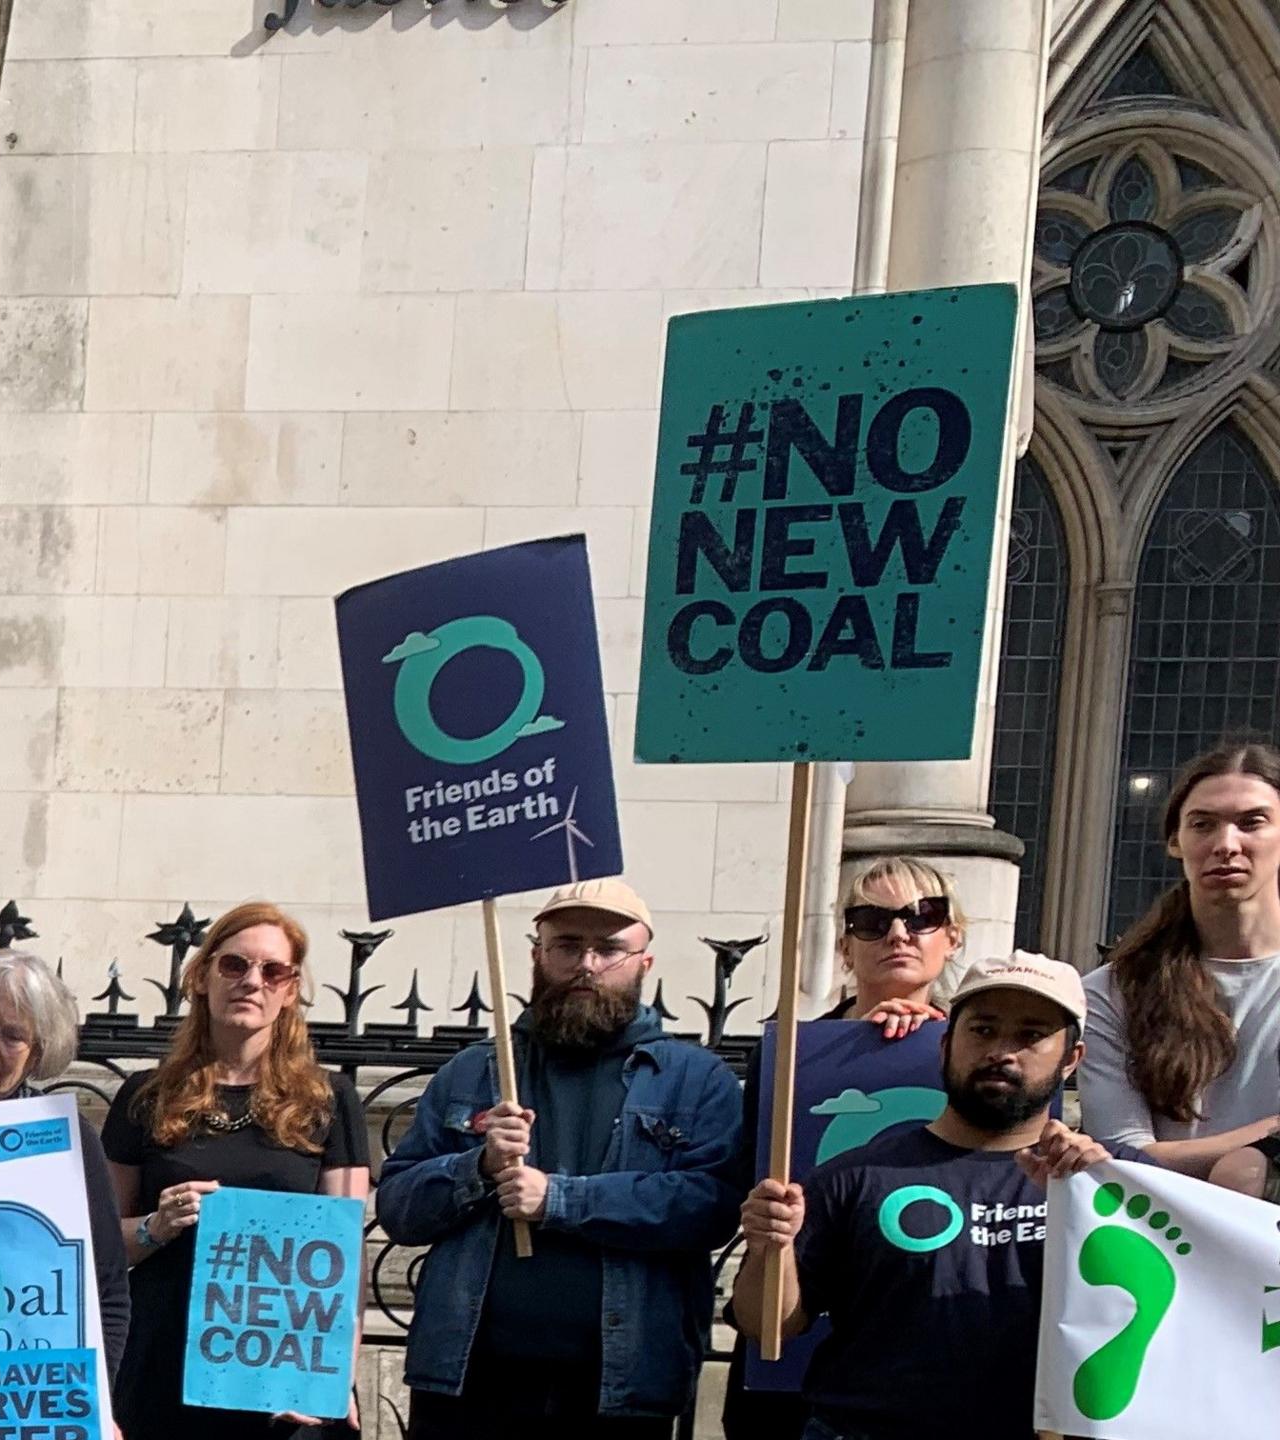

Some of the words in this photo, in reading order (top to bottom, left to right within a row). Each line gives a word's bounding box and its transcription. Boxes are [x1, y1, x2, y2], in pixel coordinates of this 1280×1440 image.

[679, 387, 973, 504] #NO
[675, 496, 967, 595] NEW
[666, 592, 953, 676] COAL
[405, 768, 519, 813] Friends
[523, 757, 557, 787] of
[408, 816, 462, 843] the
[466, 792, 559, 832] Earth
[970, 1201, 1048, 1223] Friend
[970, 1225, 1012, 1246] the
[206, 1231, 346, 1289] #NO
[204, 1282, 344, 1333] NEW
[199, 1326, 340, 1374] COAL
